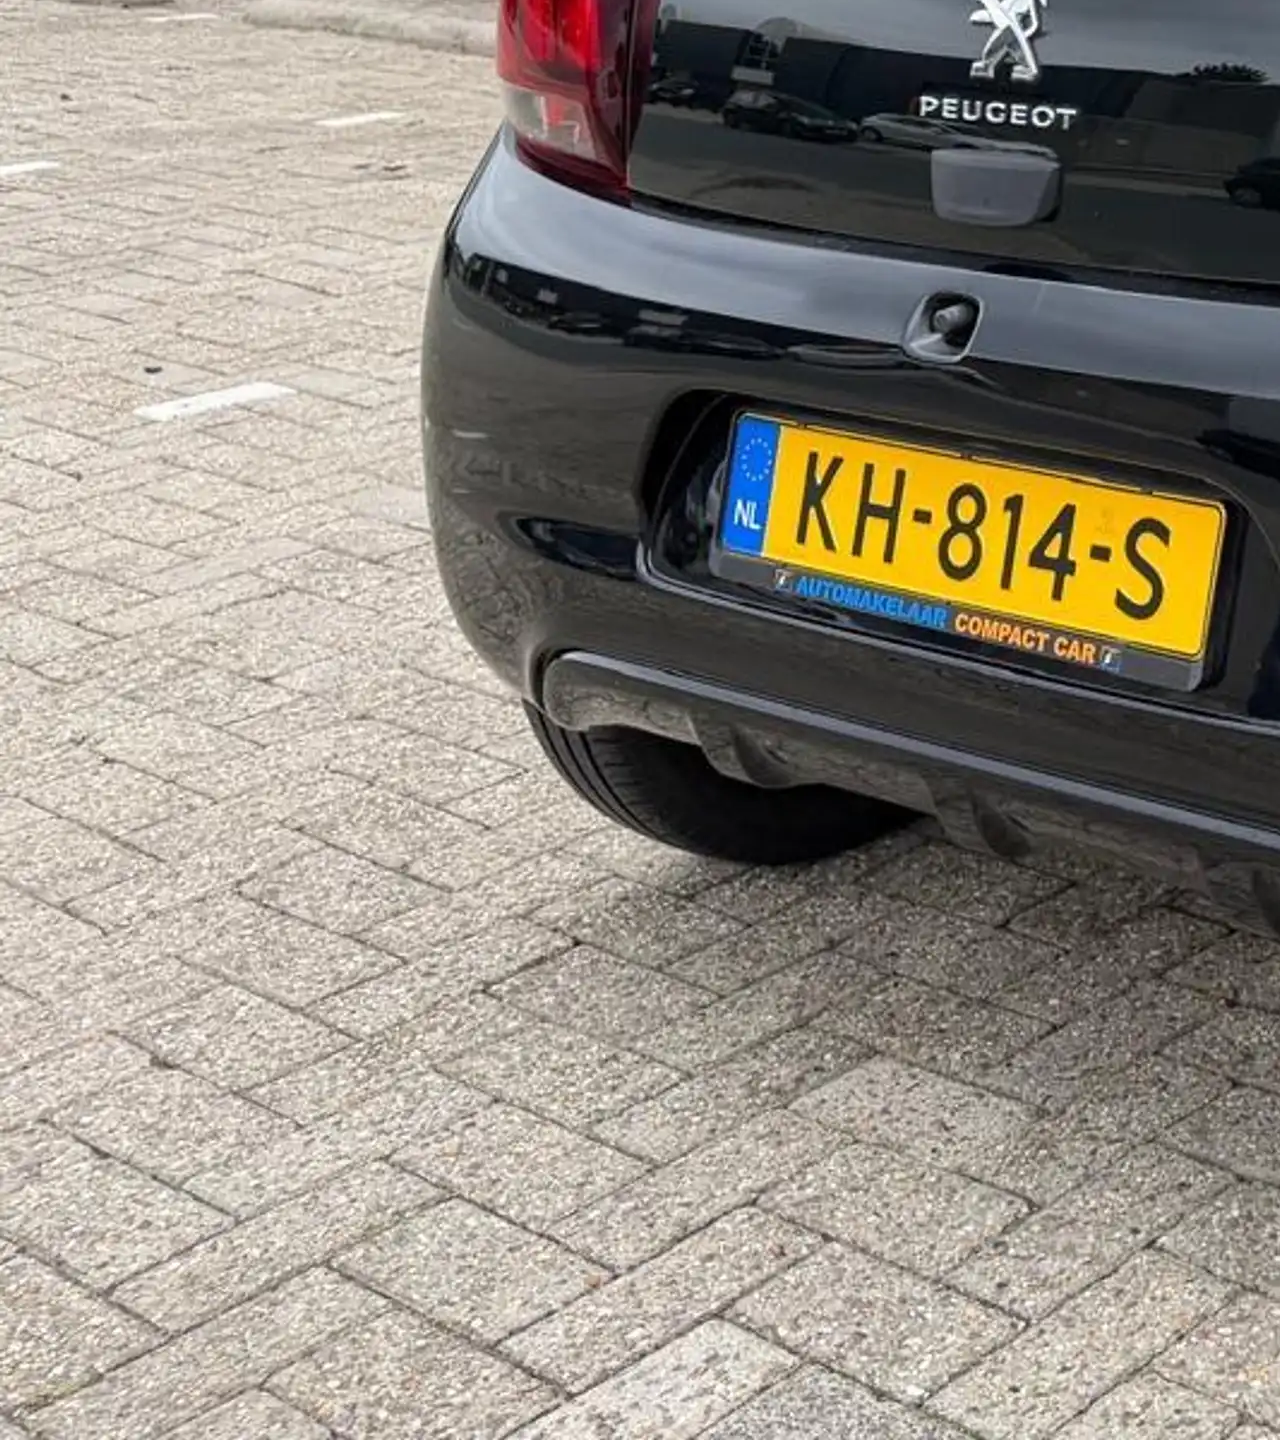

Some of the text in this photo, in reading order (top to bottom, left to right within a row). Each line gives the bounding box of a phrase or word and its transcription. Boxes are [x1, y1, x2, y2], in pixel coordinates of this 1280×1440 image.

[918, 95, 1078, 131] PEUGEOT
[733, 498, 762, 530] NL
[796, 451, 1171, 621] KH-814-S
[796, 576, 1097, 666] AUTOMAKELAAR COMPACT CAR
